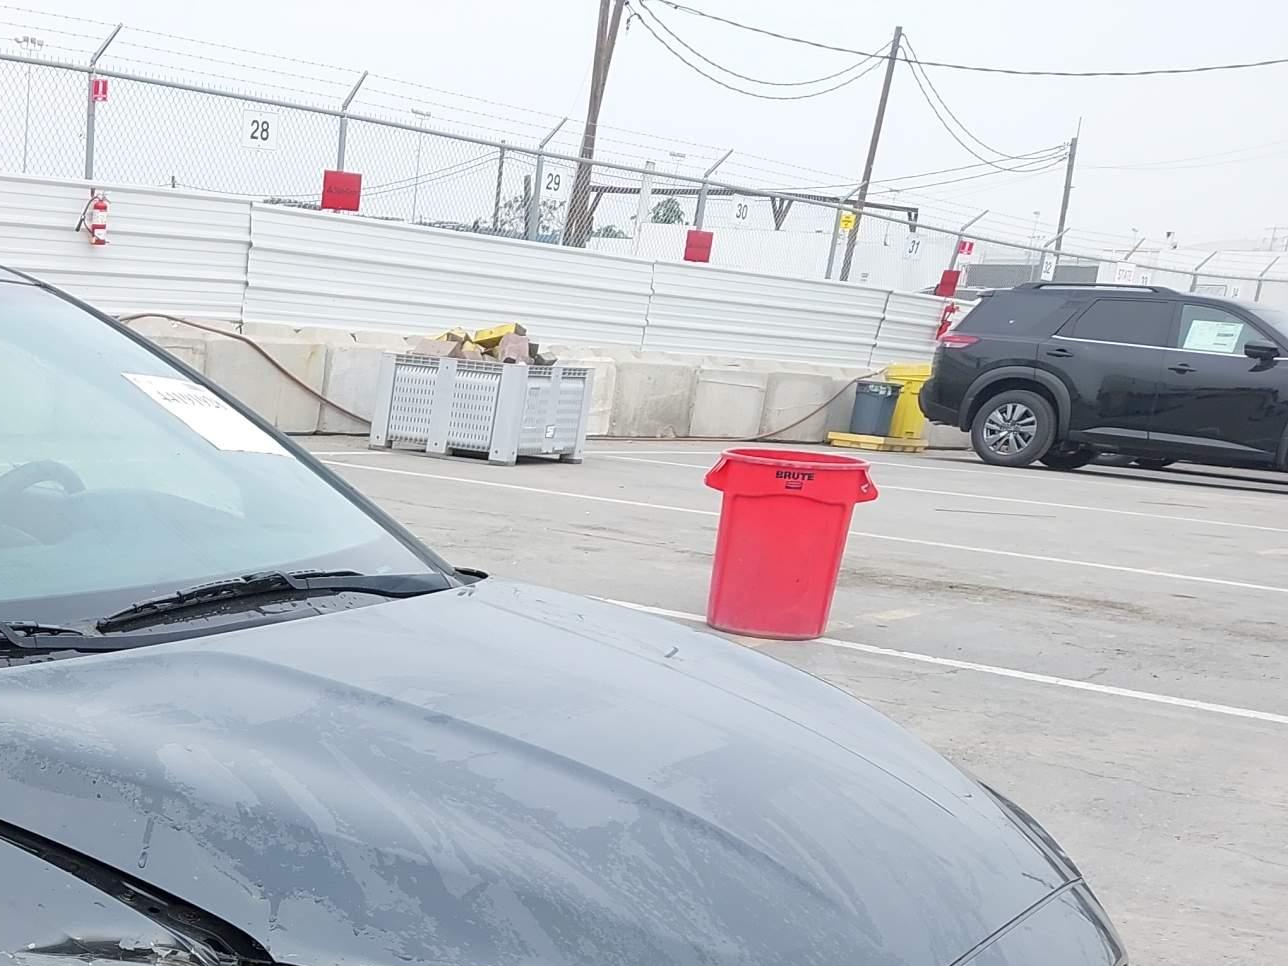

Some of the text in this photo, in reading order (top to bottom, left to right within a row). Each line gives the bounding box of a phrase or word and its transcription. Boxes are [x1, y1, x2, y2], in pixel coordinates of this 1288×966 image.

[250, 119, 270, 141] 28
[545, 172, 561, 191] 29
[735, 203, 749, 220] 30
[908, 239, 921, 254] 31
[1042, 260, 1053, 274] 32
[775, 470, 815, 481] BRUTE
